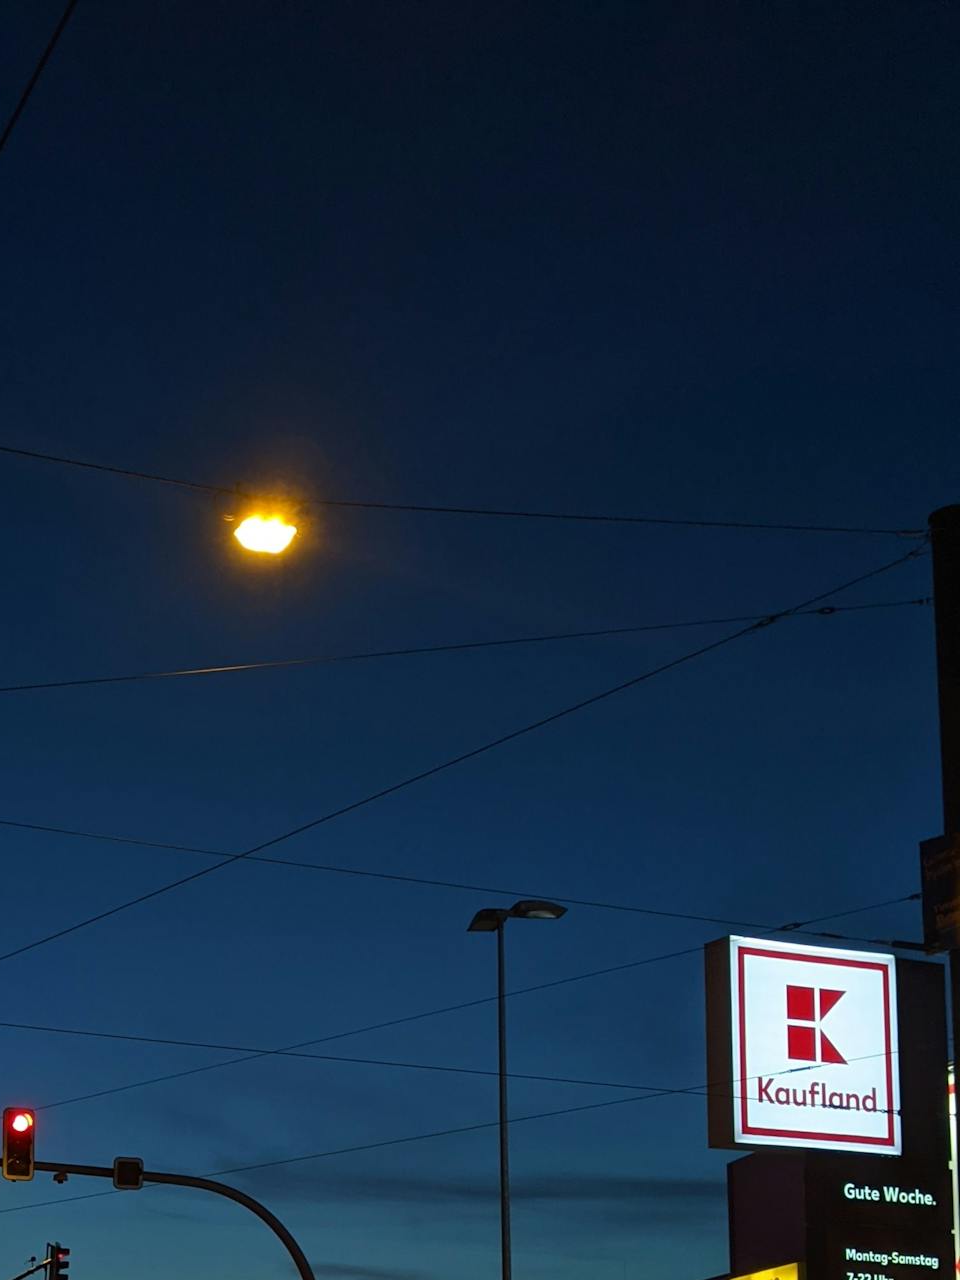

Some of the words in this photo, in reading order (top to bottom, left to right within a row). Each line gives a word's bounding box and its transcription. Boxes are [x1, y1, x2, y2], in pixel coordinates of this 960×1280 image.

[757, 1076, 878, 1113] Kaufland
[843, 1183, 880, 1201] Gute
[883, 1186, 937, 1206] Woche.
[845, 1248, 939, 1269] Montag-Samstag
